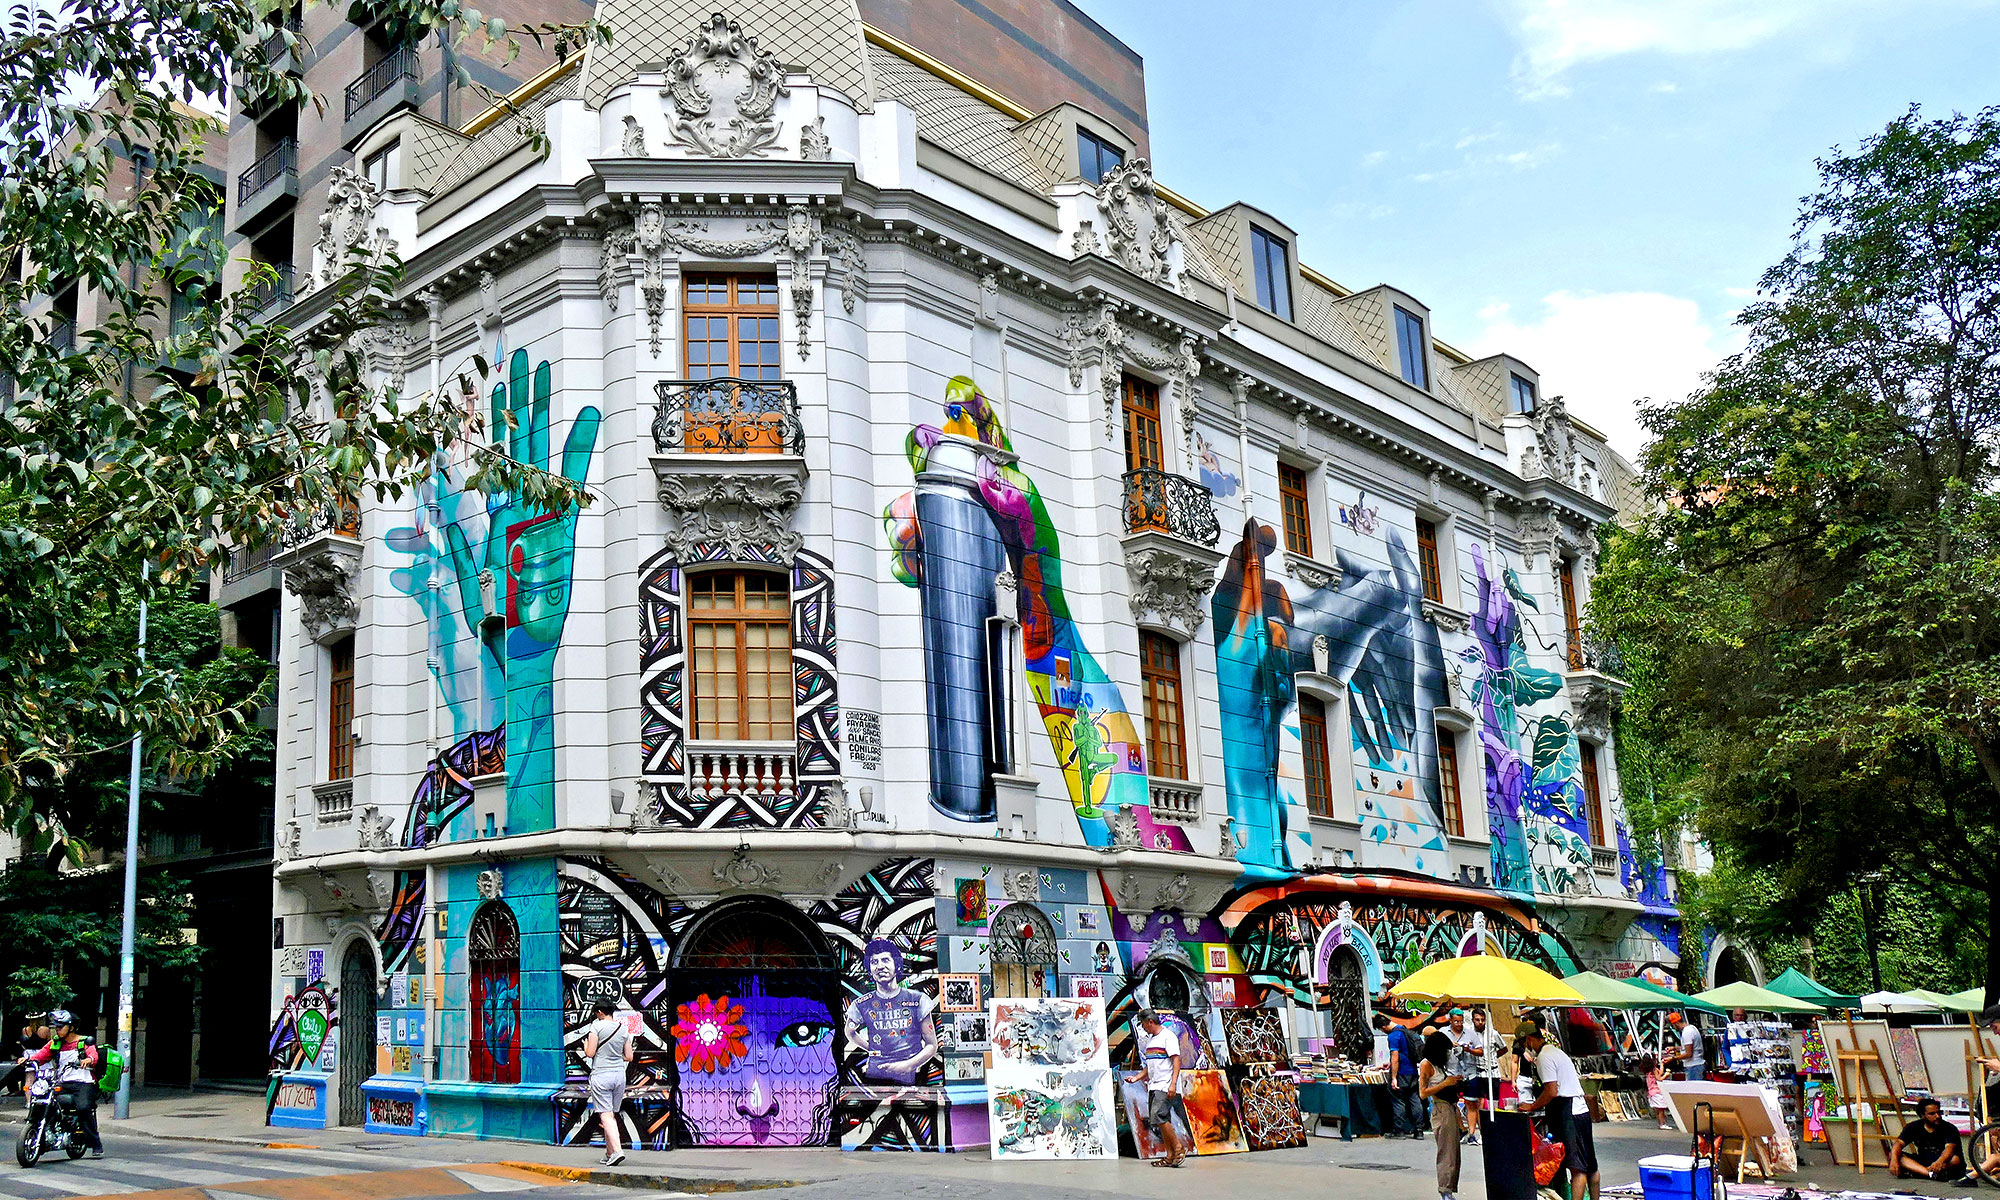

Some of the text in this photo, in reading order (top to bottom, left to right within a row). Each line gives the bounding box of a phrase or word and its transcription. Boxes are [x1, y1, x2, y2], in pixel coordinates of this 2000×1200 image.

[586, 980, 613, 996] 298
[876, 1009, 901, 1020] THE
[873, 1018, 908, 1031] CLASH
